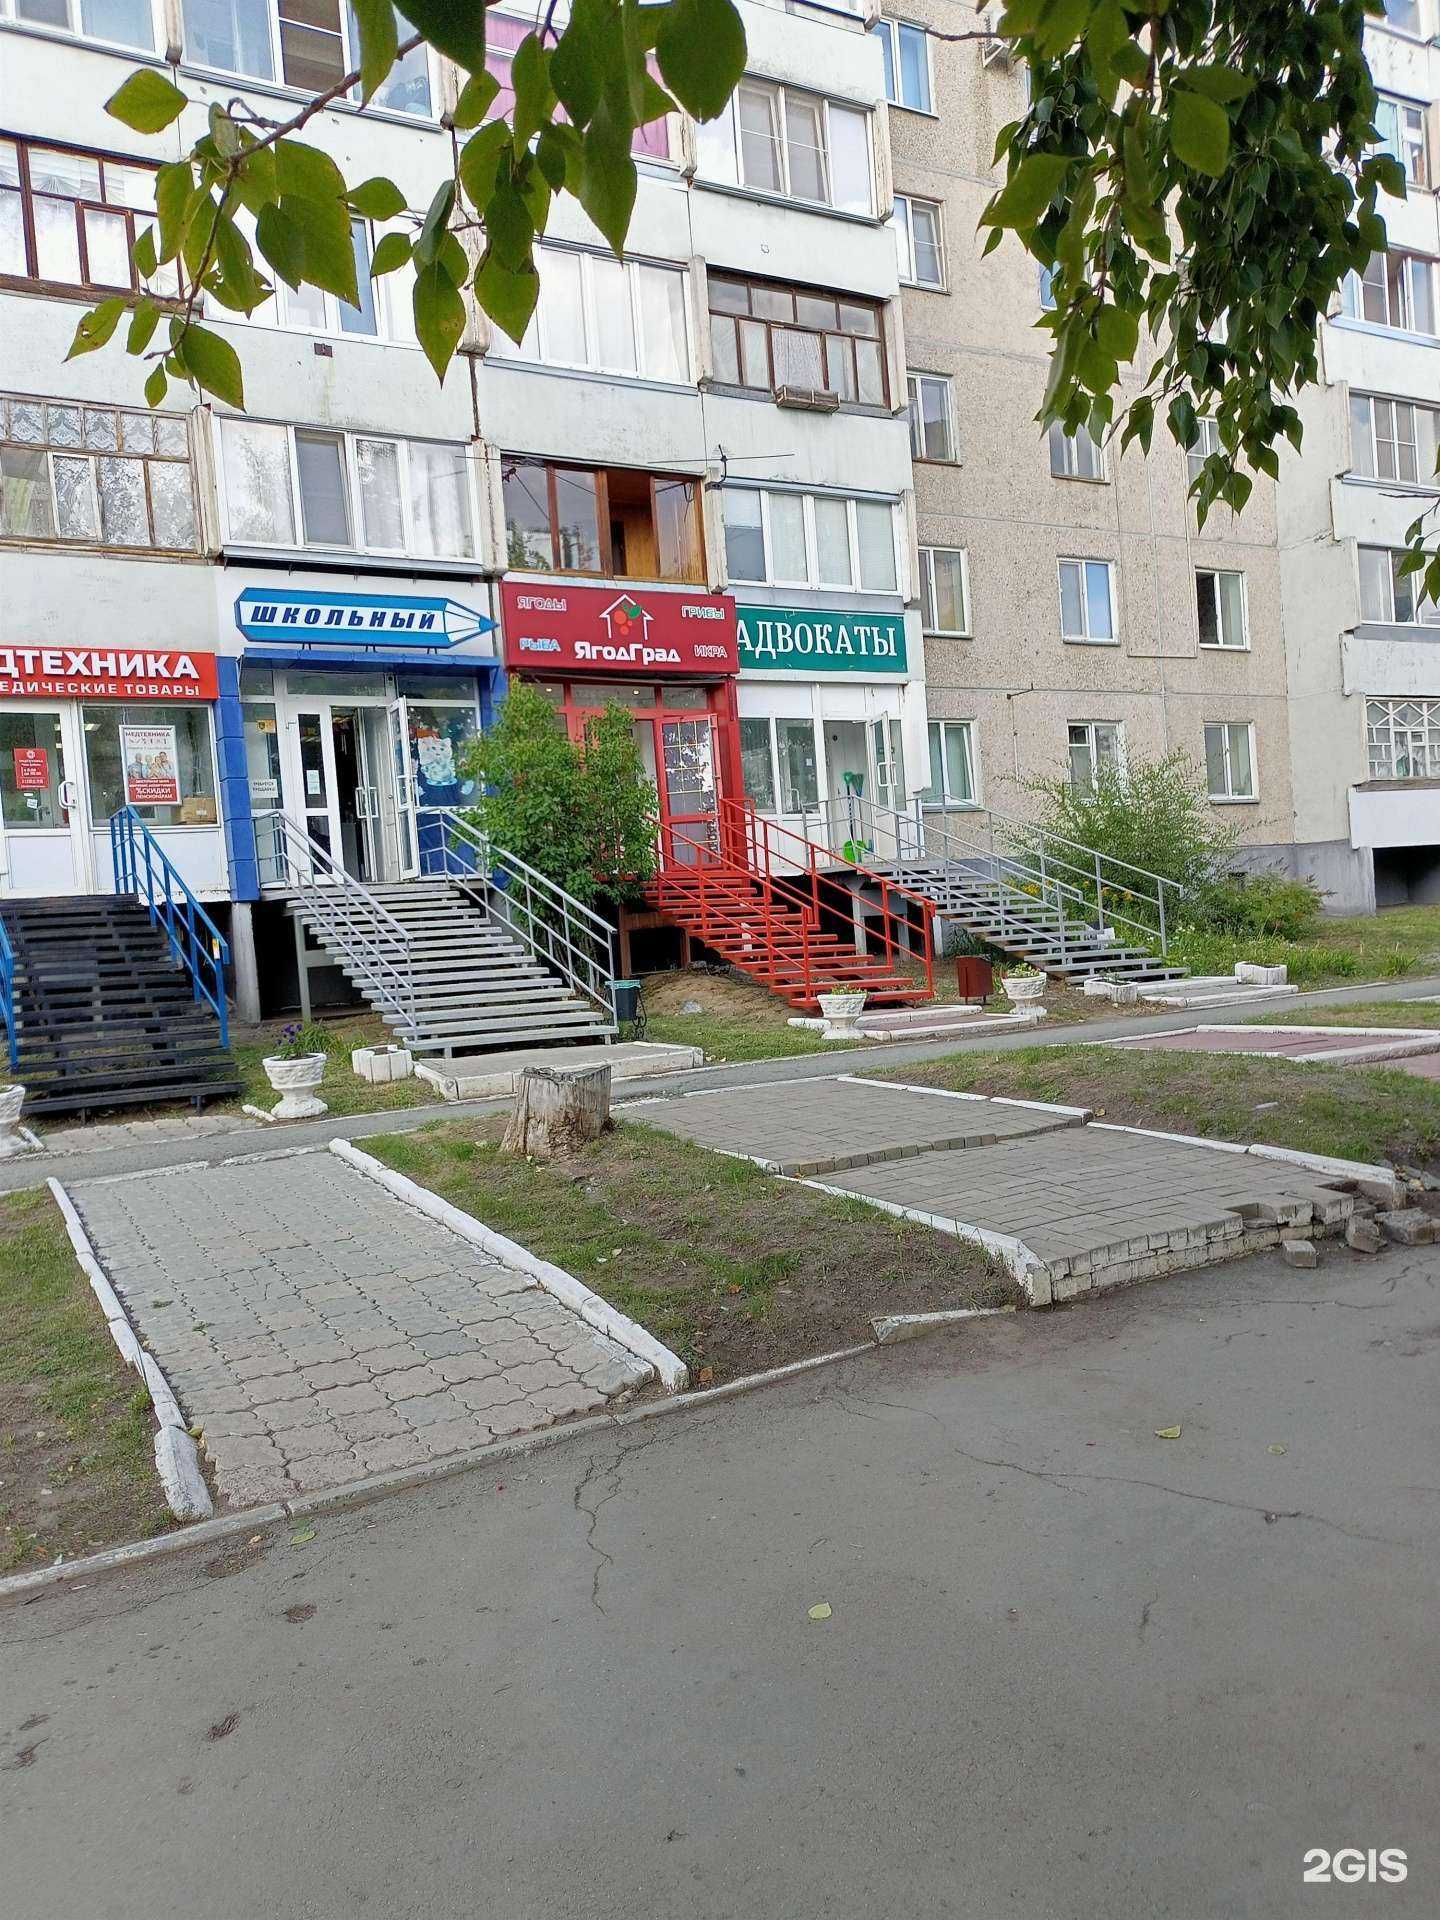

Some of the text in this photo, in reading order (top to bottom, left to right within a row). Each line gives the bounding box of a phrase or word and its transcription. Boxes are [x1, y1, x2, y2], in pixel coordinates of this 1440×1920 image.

[517, 596, 567, 611] ЯГОДЫ
[250, 605, 436, 629] ШКОЛЬНЫЙ
[682, 605, 725, 620] ГРИБЫ
[519, 637, 561, 652] РЫБА
[736, 619, 898, 660] АДВОКАТЫ
[694, 644, 727, 658] ИКРА
[124, 683, 200, 696] ТОВАРЫ
